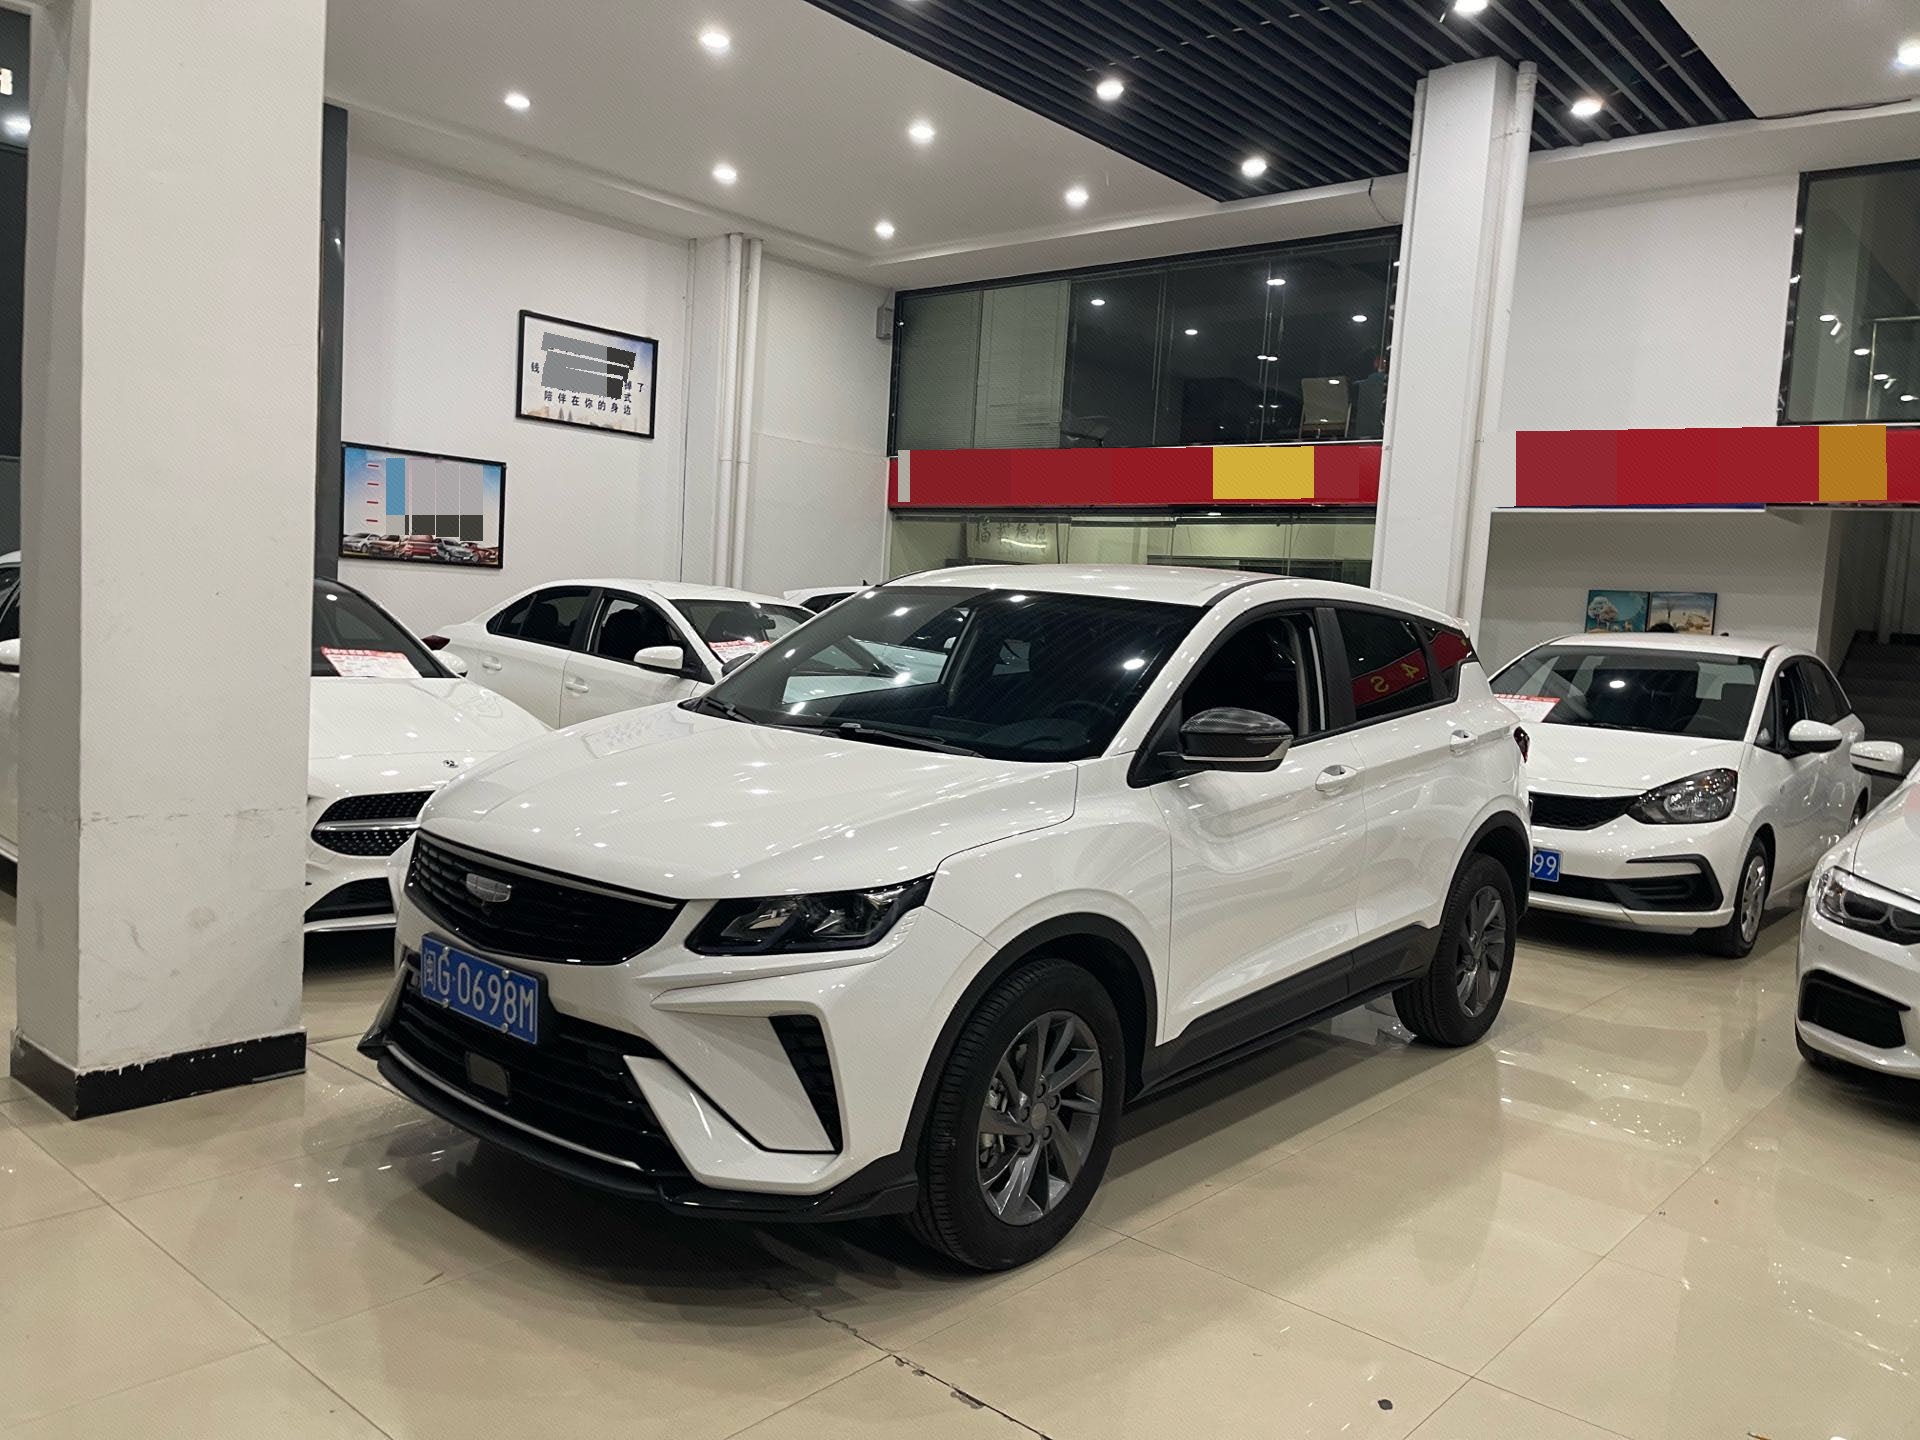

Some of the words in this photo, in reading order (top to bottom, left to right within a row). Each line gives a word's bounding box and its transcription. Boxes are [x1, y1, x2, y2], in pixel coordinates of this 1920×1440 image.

[543, 390, 632, 416] 陪伴在你的身边
